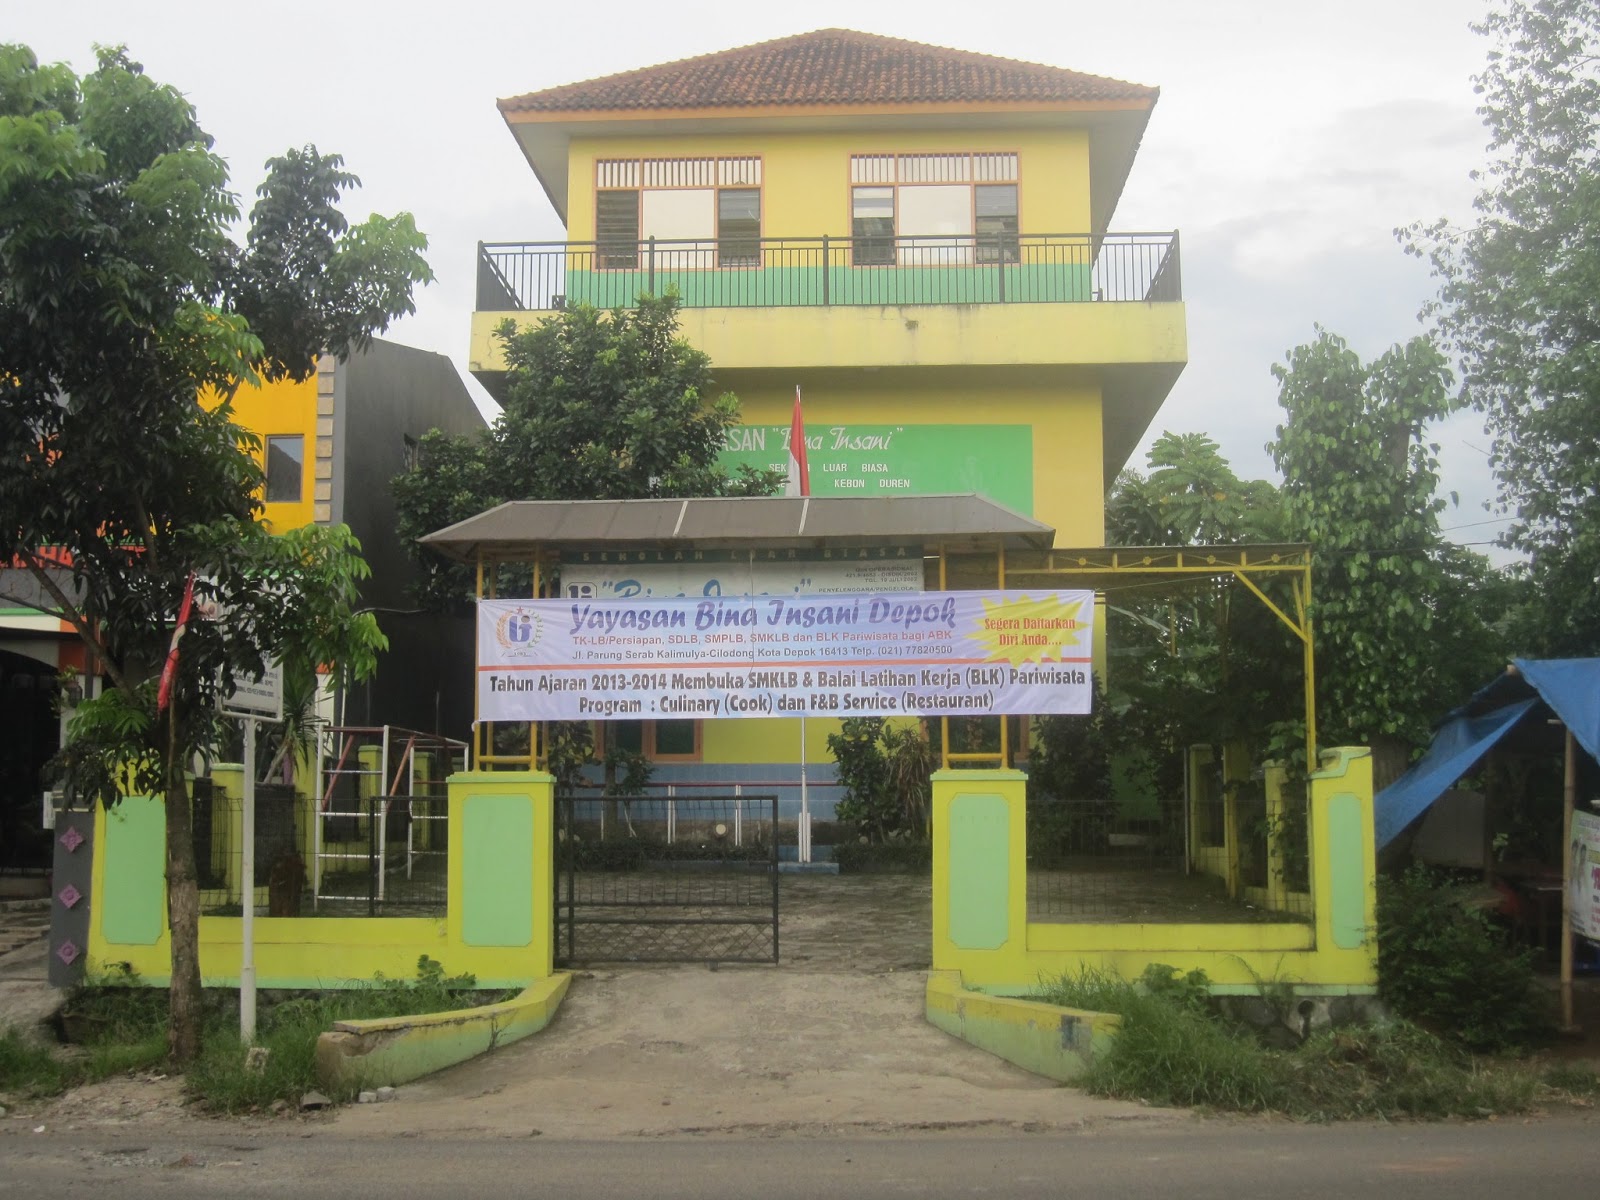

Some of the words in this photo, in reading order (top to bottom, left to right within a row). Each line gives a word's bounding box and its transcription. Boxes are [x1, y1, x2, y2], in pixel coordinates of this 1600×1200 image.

[823, 463, 847, 472] LUAR
[861, 463, 889, 473] BIASA
[834, 479, 865, 488] KEBON
[879, 478, 910, 488] DUREN
[570, 603, 685, 634] Yayasan
[695, 601, 758, 630] Bina
[767, 598, 859, 628] Insani
[869, 597, 956, 629] Depok
[984, 618, 1020, 631] Segera
[573, 635, 665, 646] TK-LB/Persiapan,
[668, 635, 700, 646] SDLB,
[704, 634, 746, 645] SMPLB,
[750, 633, 789, 643] SMKLB
[793, 633, 813, 642] dan
[816, 632, 839, 641] BLK
[842, 631, 898, 641] Pariwisata
[901, 631, 925, 642] bagi
[927, 630, 952, 640] ABK
[999, 634, 1018, 646] Diri
[572, 651, 585, 660] Jl.
[587, 651, 623, 661] Parung
[625, 650, 654, 659] Serab
[657, 648, 754, 660] Kalimulya-Cilodong
[757, 648, 781, 657] Kota
[783, 647, 816, 658] Depok
[819, 647, 848, 656] 16413
[850, 646, 873, 657] Telp.
[878, 646, 902, 656] (021)
[905, 645, 953, 655] 77820500
[490, 675, 534, 692] Tahun
[538, 674, 587, 694] Ajaran
[591, 673, 667, 690] 2013-2014
[671, 672, 744, 690] Membuka
[749, 671, 797, 689] SMKLB
[802, 671, 813, 688] &
[817, 670, 856, 688] Balai
[861, 669, 917, 687] Latihan
[922, 668, 961, 689] Kerja
[965, 667, 1005, 689] (BLK)
[1009, 667, 1085, 685] Pariwisata
[579, 696, 641, 717] Program
[659, 693, 720, 716] Culinary
[724, 692, 773, 715] (Cook)
[777, 693, 806, 711] dan
[810, 693, 838, 710] F&B
[843, 692, 897, 710] Service
[901, 689, 994, 713] (Restaurant)
